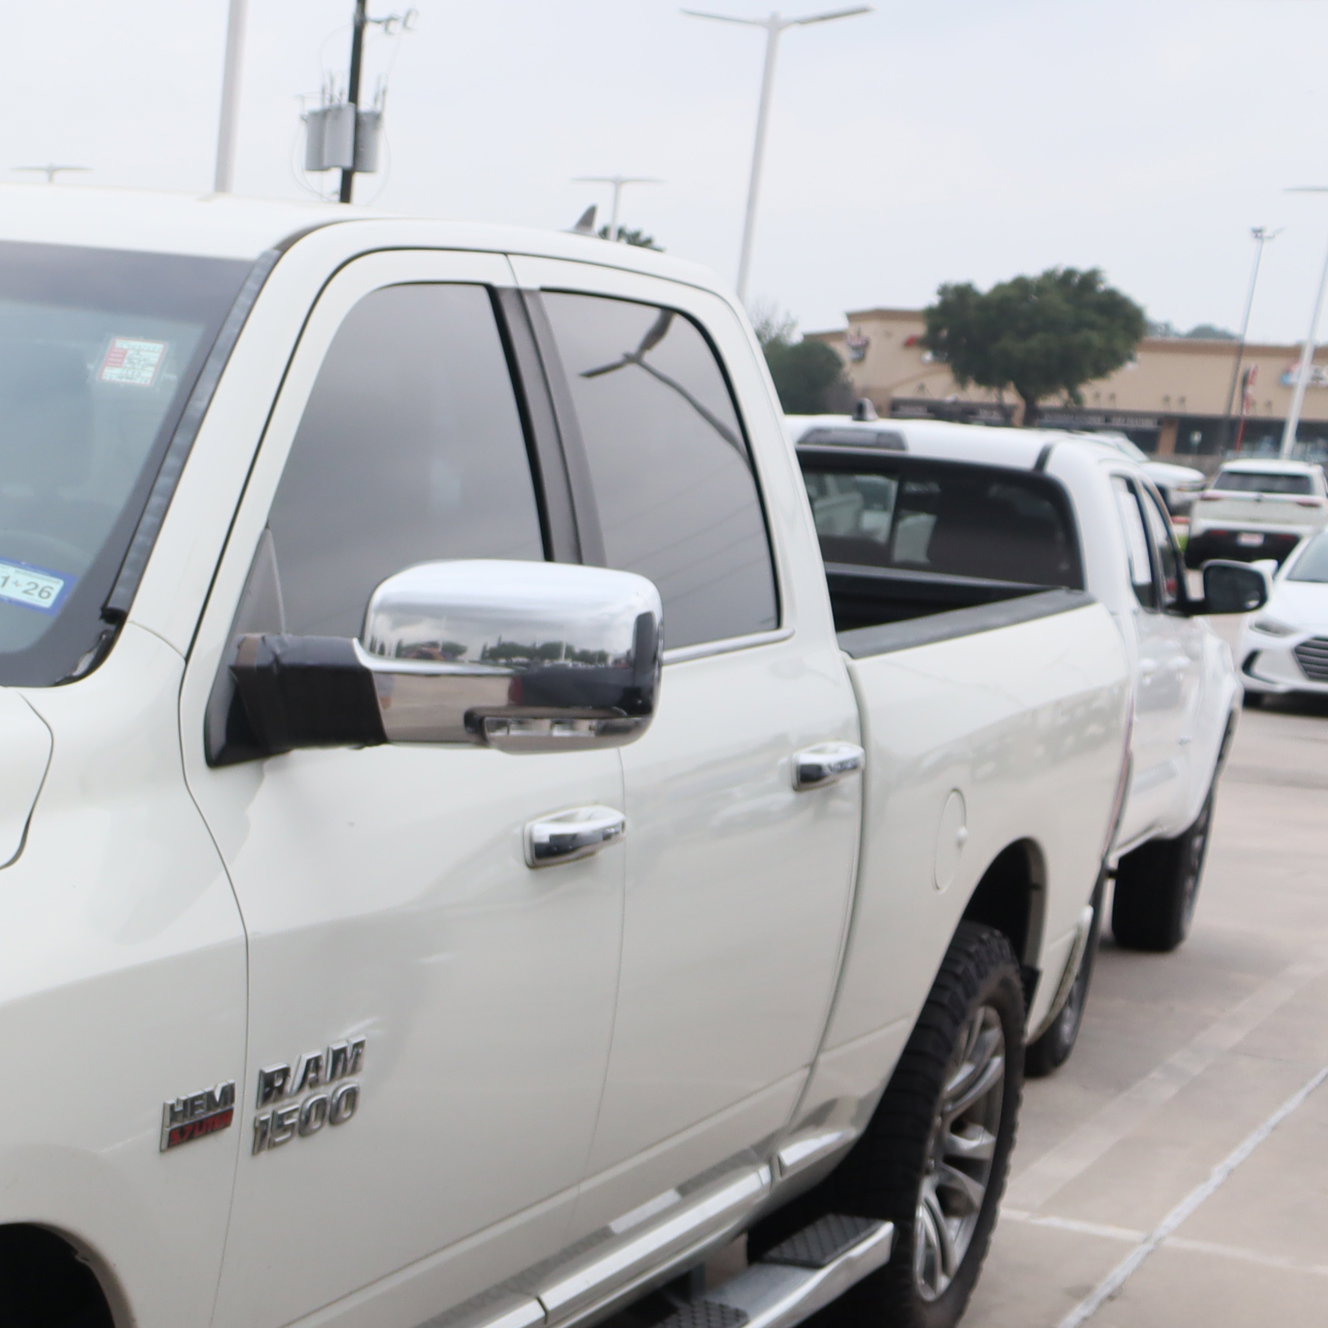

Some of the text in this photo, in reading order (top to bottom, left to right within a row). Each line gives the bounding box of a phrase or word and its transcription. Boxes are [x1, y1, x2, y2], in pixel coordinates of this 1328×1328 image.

[162, 1079, 235, 1130] HEMI
[256, 1034, 367, 1109] RAM
[251, 1083, 361, 1156] 1500
